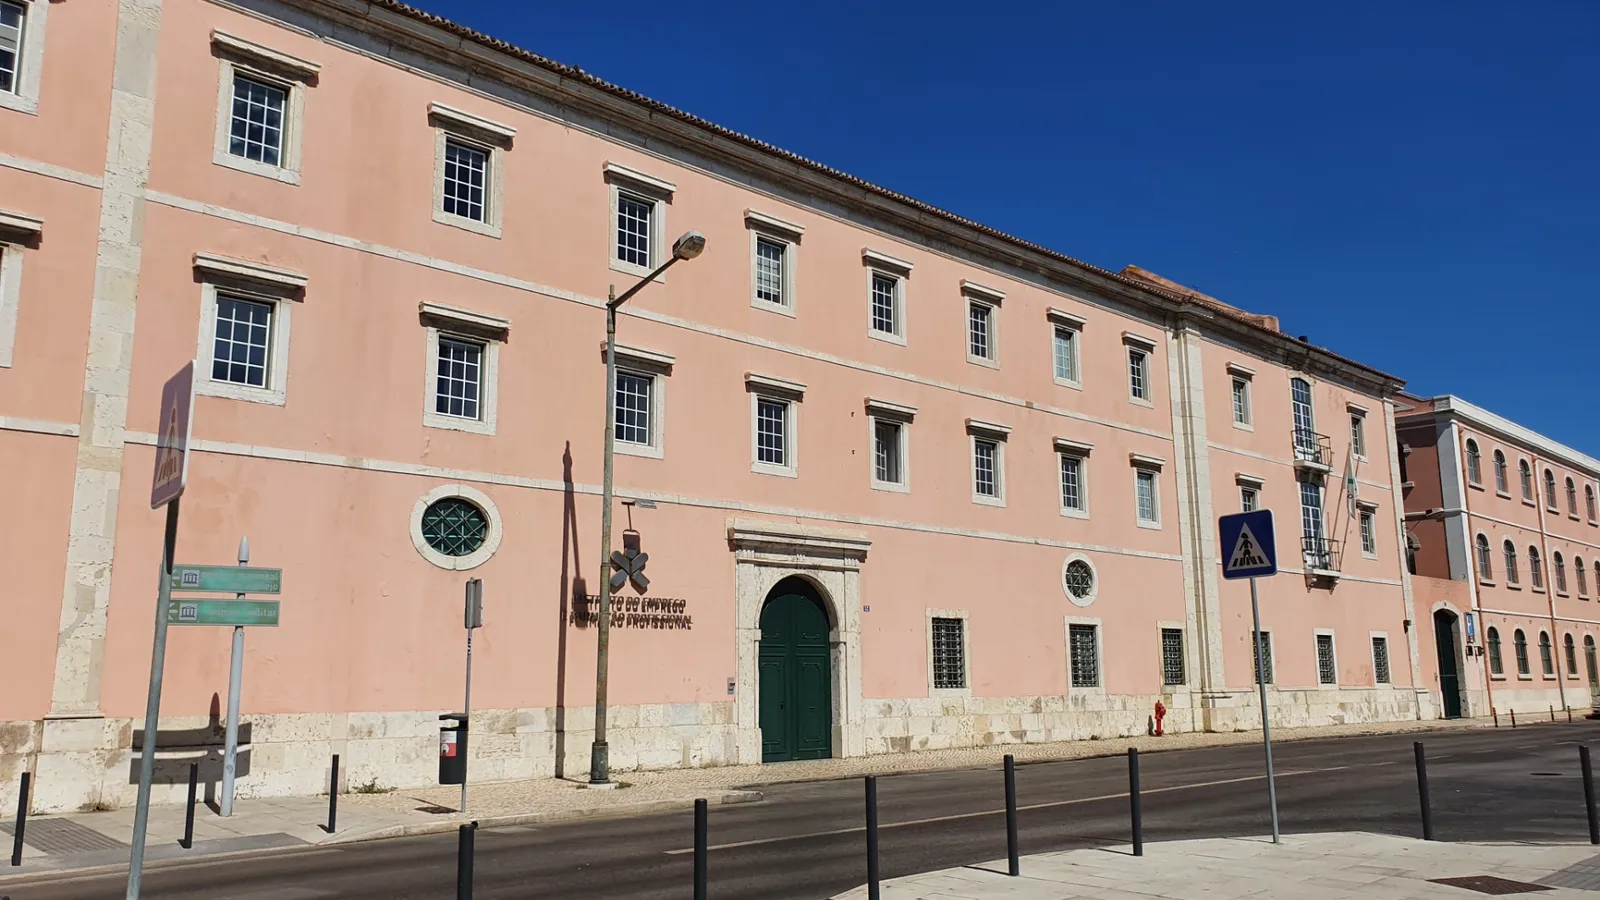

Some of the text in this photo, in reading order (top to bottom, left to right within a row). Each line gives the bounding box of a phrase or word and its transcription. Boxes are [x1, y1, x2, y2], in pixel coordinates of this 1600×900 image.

[626, 597, 640, 612] DO
[641, 597, 687, 614] EMPREGO
[626, 613, 693, 630] PROFISSIONAL
